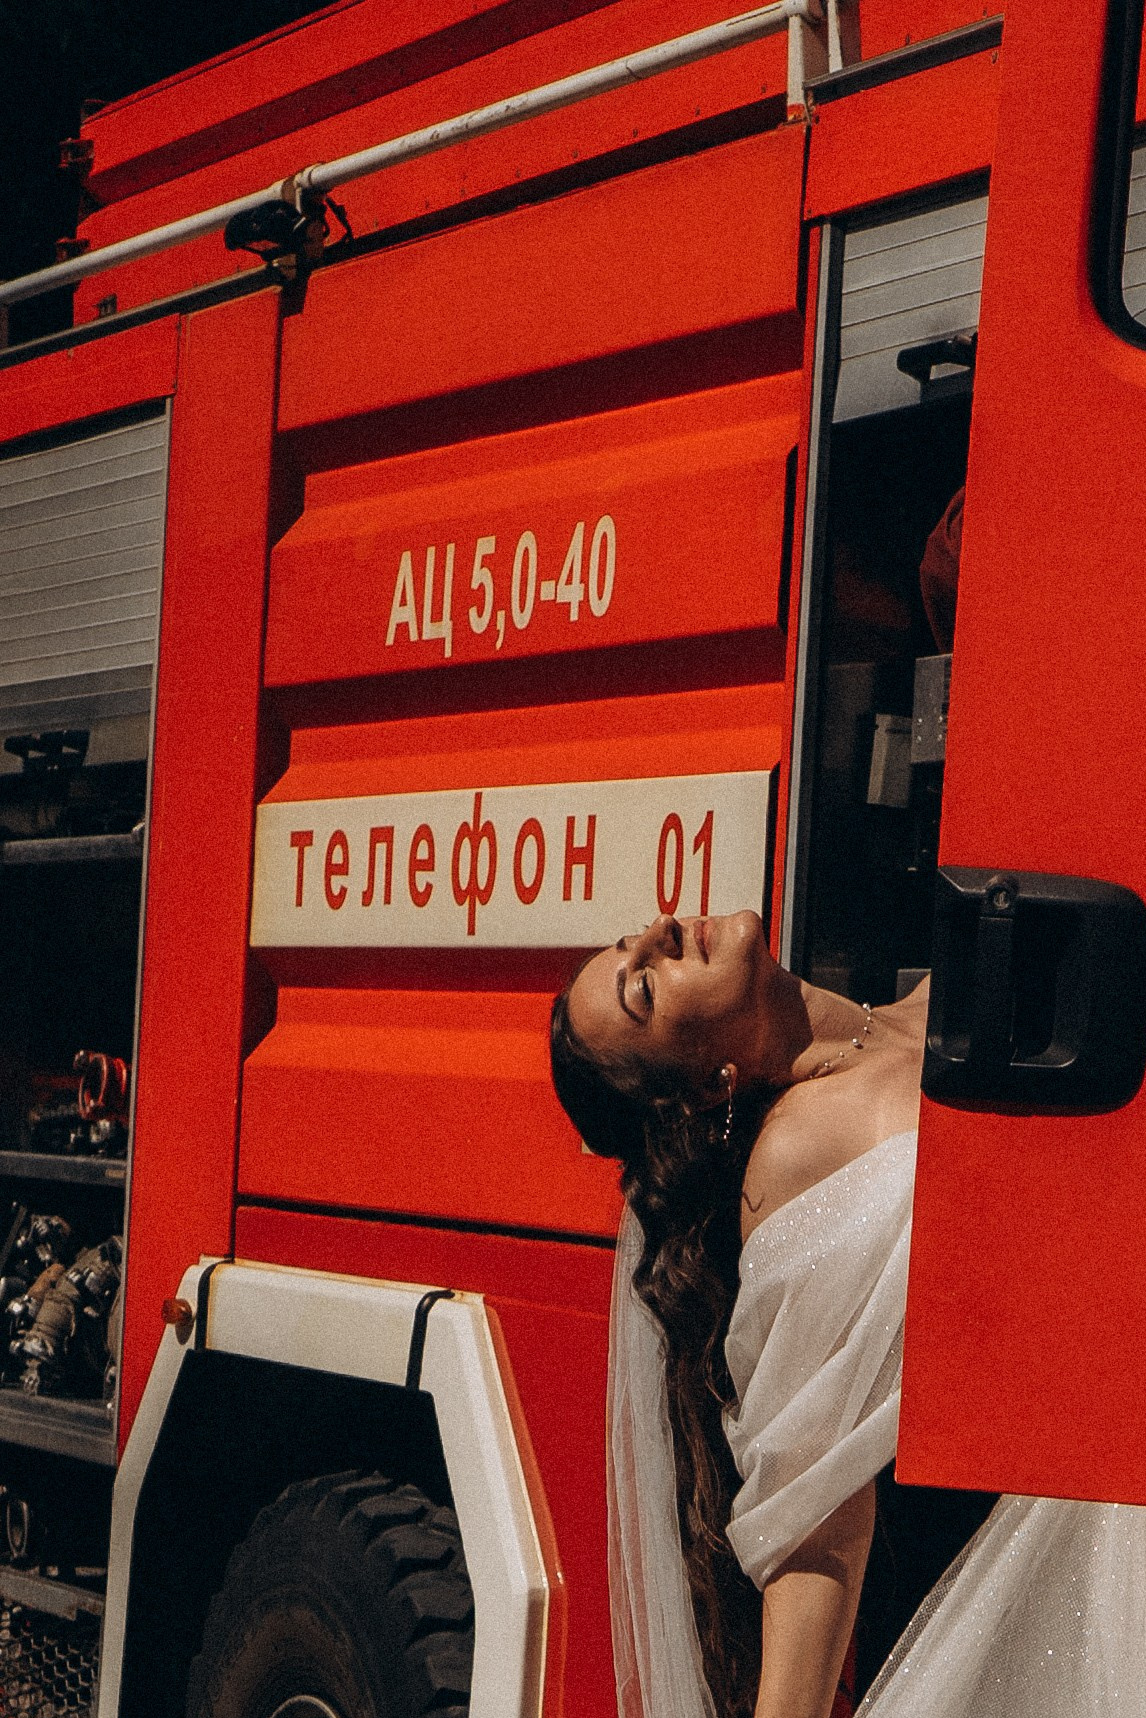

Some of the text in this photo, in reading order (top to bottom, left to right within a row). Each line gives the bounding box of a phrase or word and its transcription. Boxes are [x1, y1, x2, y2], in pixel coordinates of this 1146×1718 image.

[386, 515, 616, 658] АЦ 5,0-40
[289, 792, 714, 936] телефон 01
